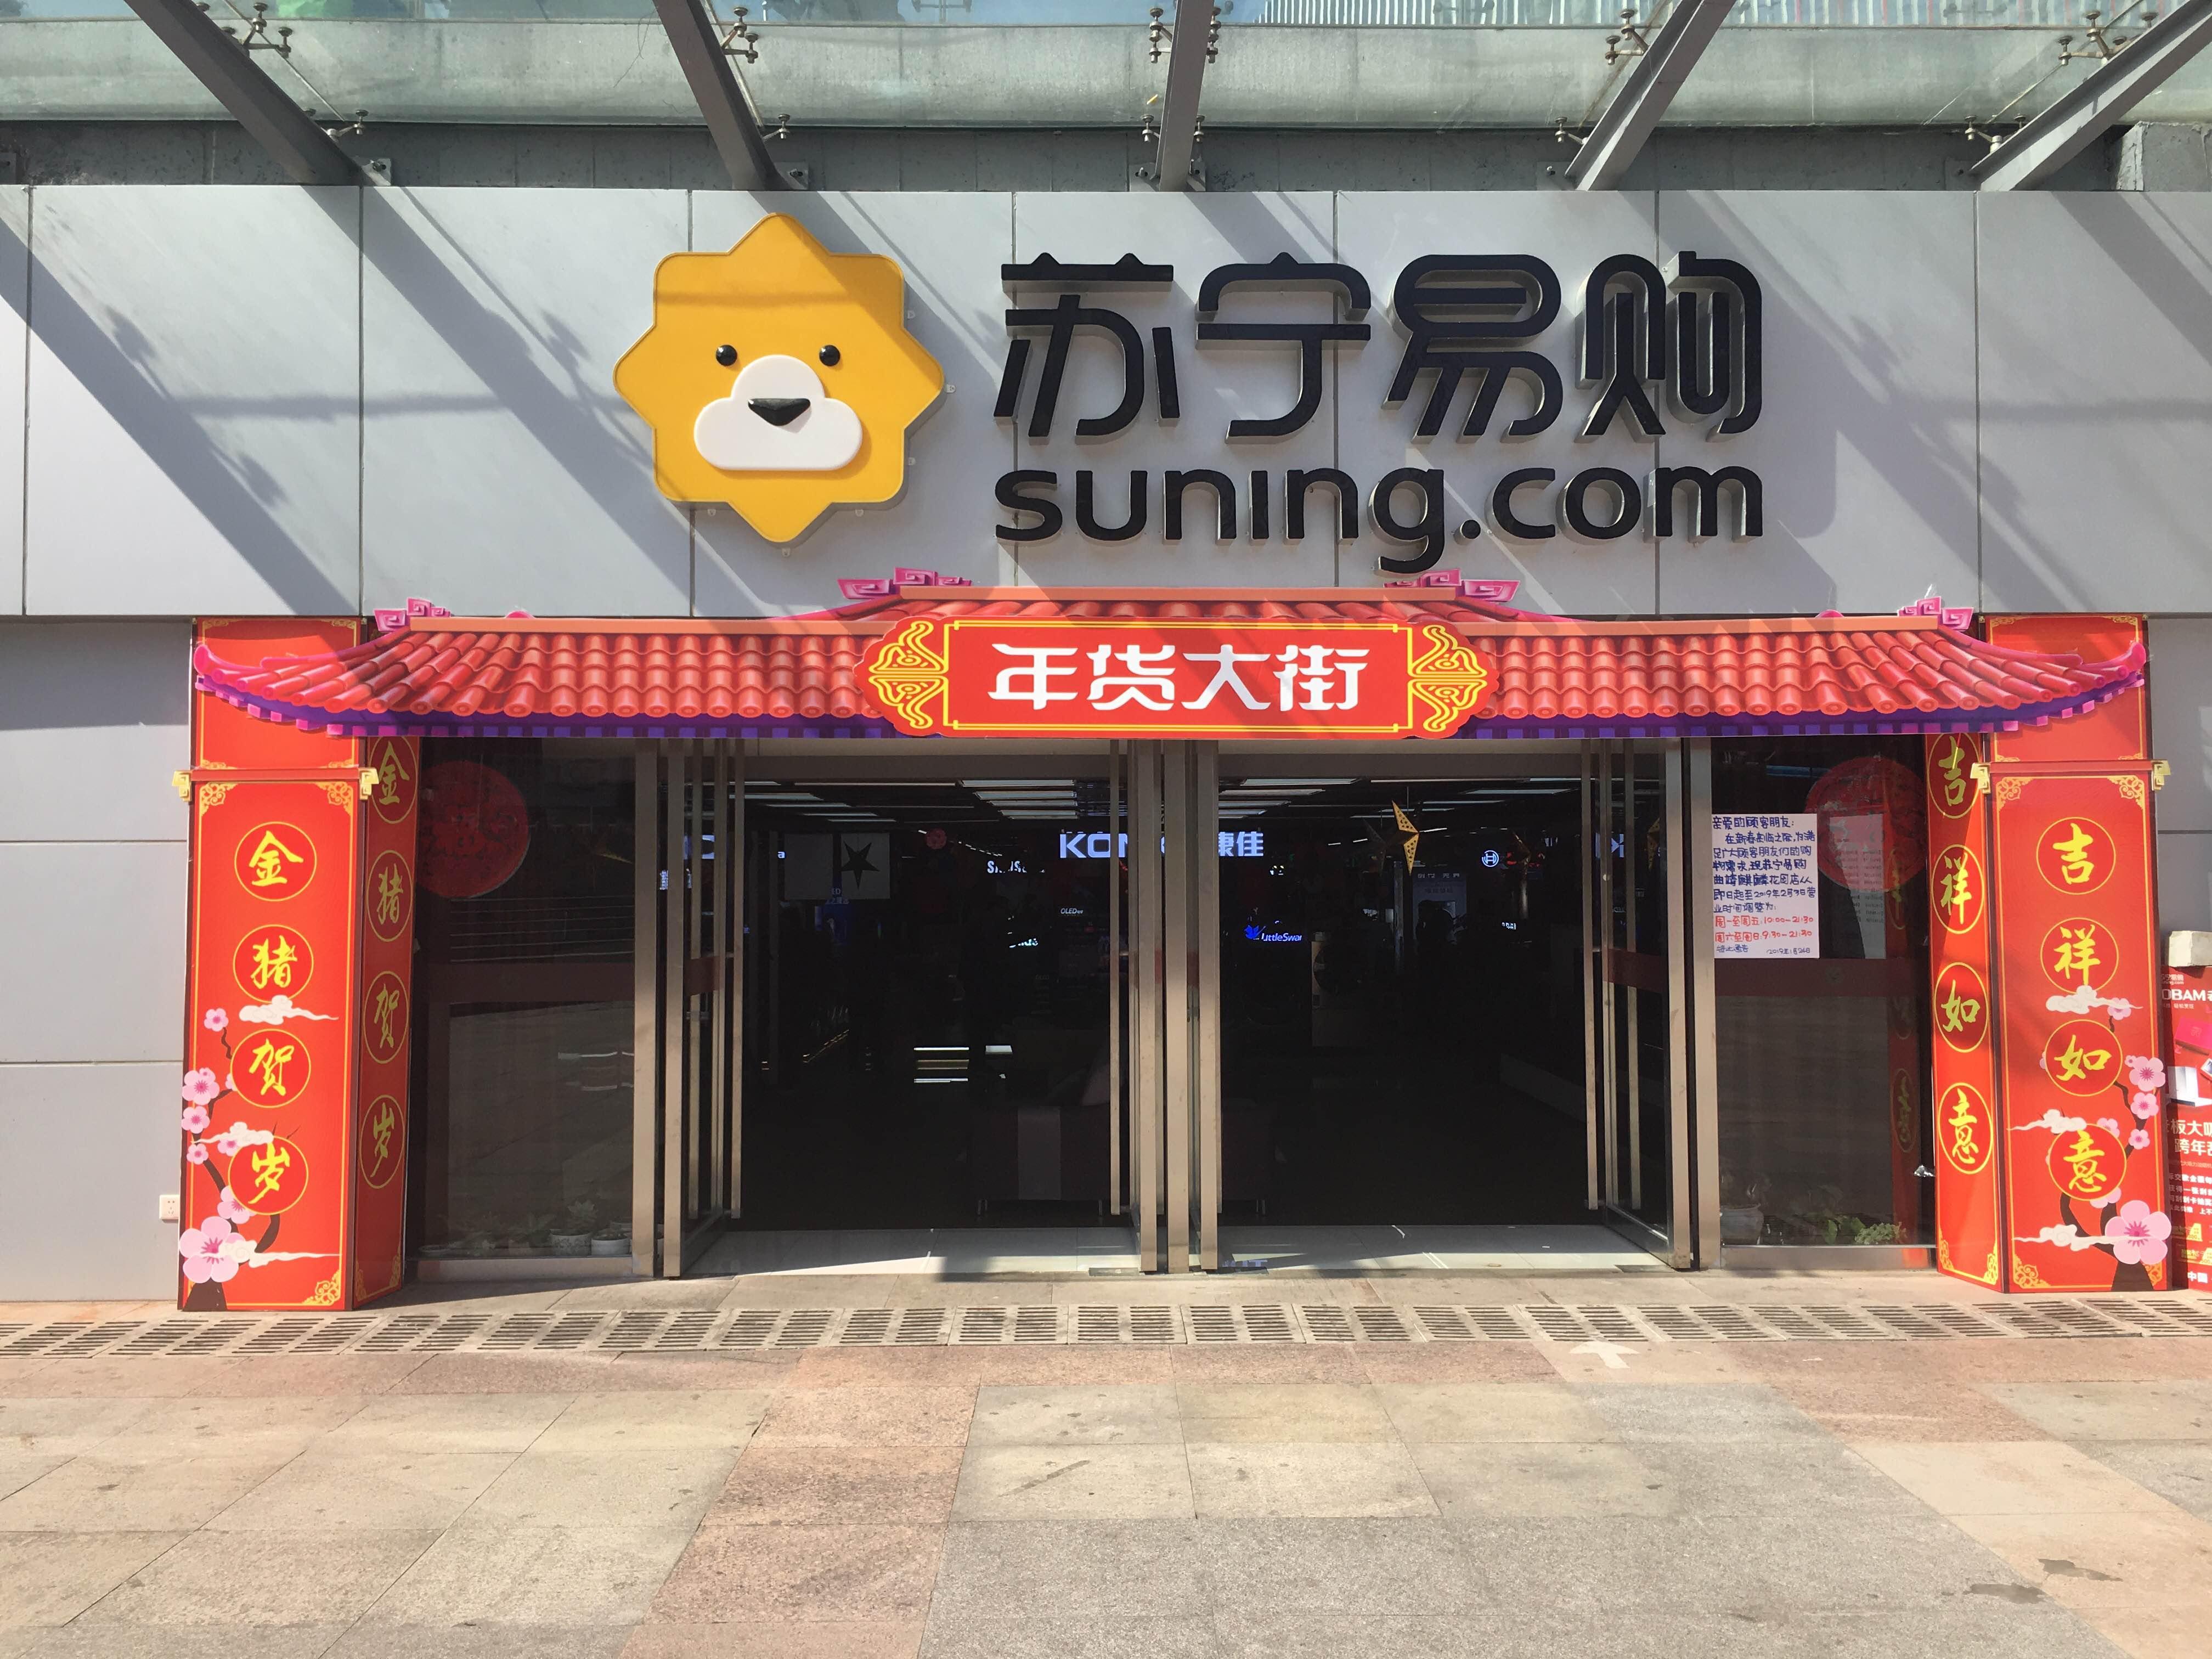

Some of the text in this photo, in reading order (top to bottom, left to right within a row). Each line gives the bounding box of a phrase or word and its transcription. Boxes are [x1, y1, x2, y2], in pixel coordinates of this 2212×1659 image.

[994, 250, 1763, 441] 苏宁易购
[994, 466, 1763, 573] suning.com
[988, 643, 1370, 712] 年货大街
[248, 830, 303, 1205] 金猪贺岁
[370, 740, 409, 1179] 金猪贺岁
[1939, 735, 1980, 1165] 吉祥如意
[2052, 822, 2112, 1195] 吉祥如意
[2162, 989, 2206, 1001] OBAM
